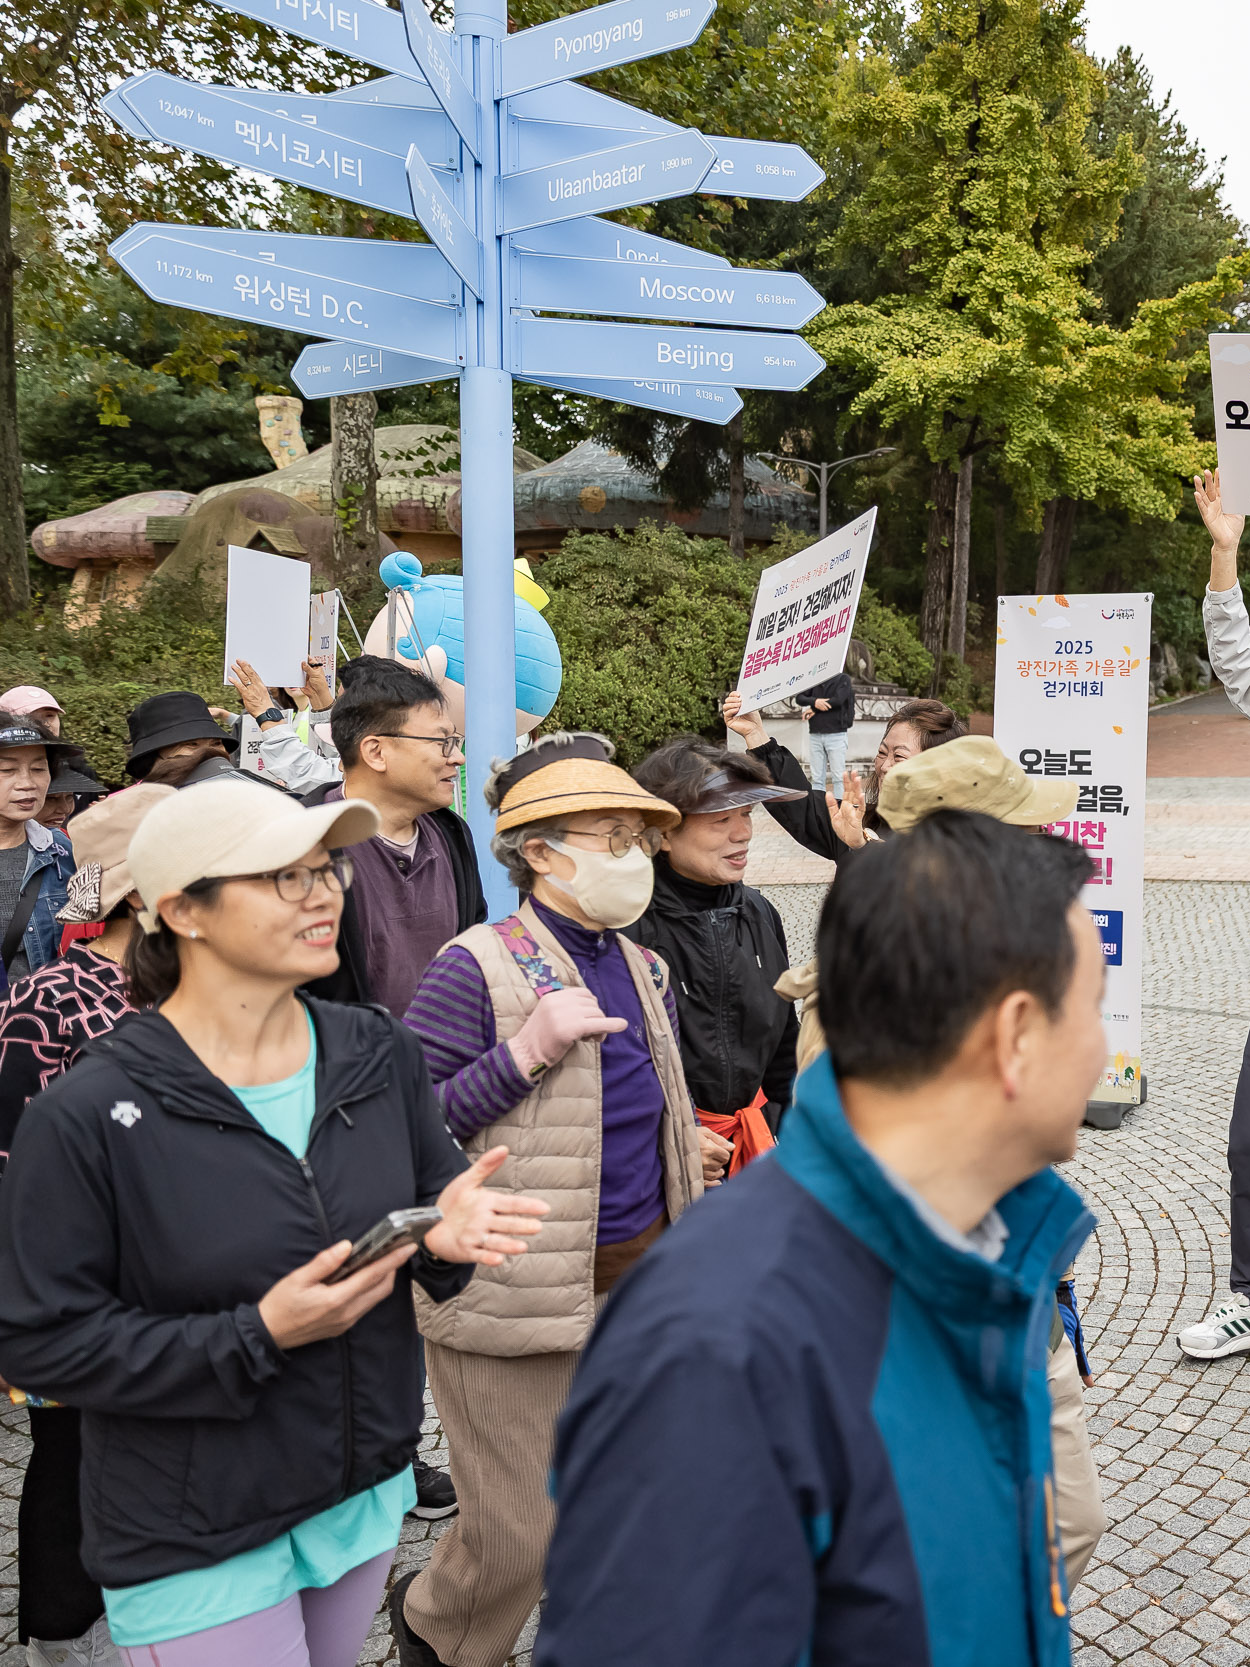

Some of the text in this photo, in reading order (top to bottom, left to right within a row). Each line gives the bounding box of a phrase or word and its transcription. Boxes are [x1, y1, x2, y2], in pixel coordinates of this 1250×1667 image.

[666, 8, 691, 22] 196 km
[554, 17, 643, 62] Pyongyang
[158, 99, 215, 128] 12,047 km
[235, 118, 363, 187] 멕시코시티
[681, 156, 693, 167] km
[548, 163, 646, 202] Ulaanbaatar
[755, 164, 797, 177] 8,058 km
[156, 260, 213, 284] 11,172 km
[233, 273, 370, 329] 워싱턴 D.C.
[639, 276, 735, 305] Moscow
[756, 293, 797, 305] 6,618 km
[342, 349, 384, 379] 시드니
[656, 342, 735, 372] Beijing
[763, 356, 797, 367] 954 km
[756, 568, 856, 641] 매일 걷자! 건강해지자!
[743, 640, 784, 679] 걸을수록
[782, 634, 795, 662] 더
[793, 604, 851, 659] 건강해집니다
[1054, 640, 1093, 655] 2025
[1016, 658, 1132, 678] 광진가족 가을길
[1043, 681, 1104, 698] 걷기대회
[1019, 748, 1093, 776] 오늘도
[1076, 785, 1130, 816] 걸음,
[1041, 820, 1107, 850] 기찬
